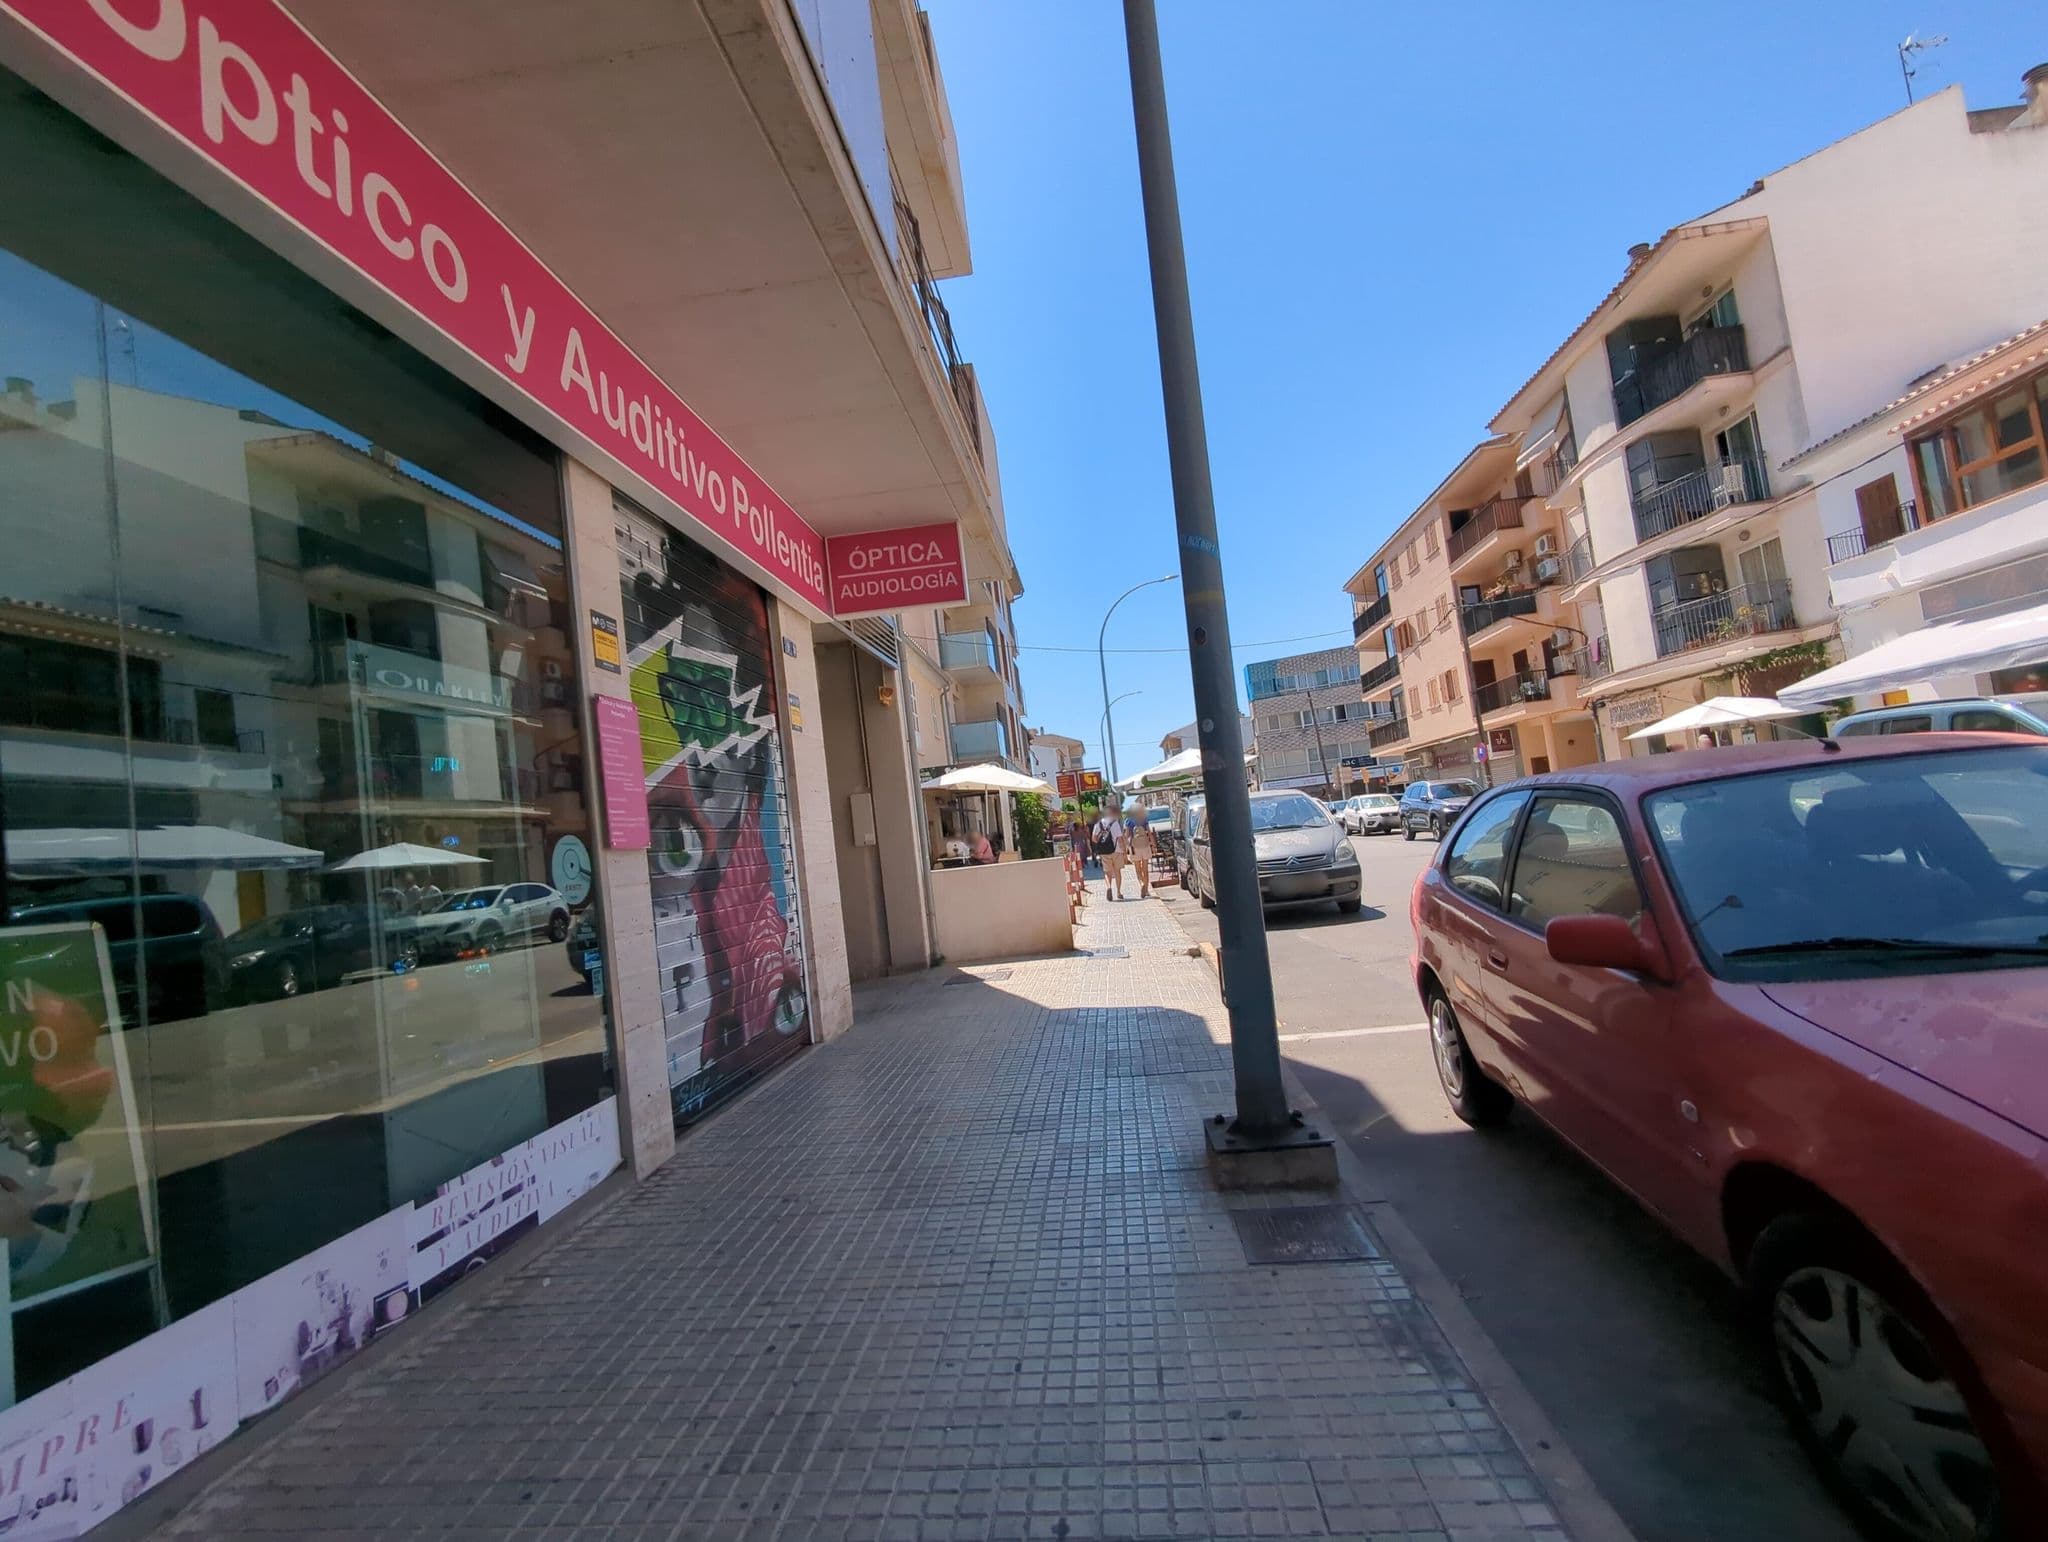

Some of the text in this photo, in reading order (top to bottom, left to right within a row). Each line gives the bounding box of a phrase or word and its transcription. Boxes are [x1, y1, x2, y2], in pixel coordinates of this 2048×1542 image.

[501, 284, 535, 374] y
[561, 327, 726, 515] Auditivo
[732, 475, 825, 596] Pollentia
[848, 541, 944, 570] ÓPTICA
[840, 569, 959, 599] AUDIOLOGÍA
